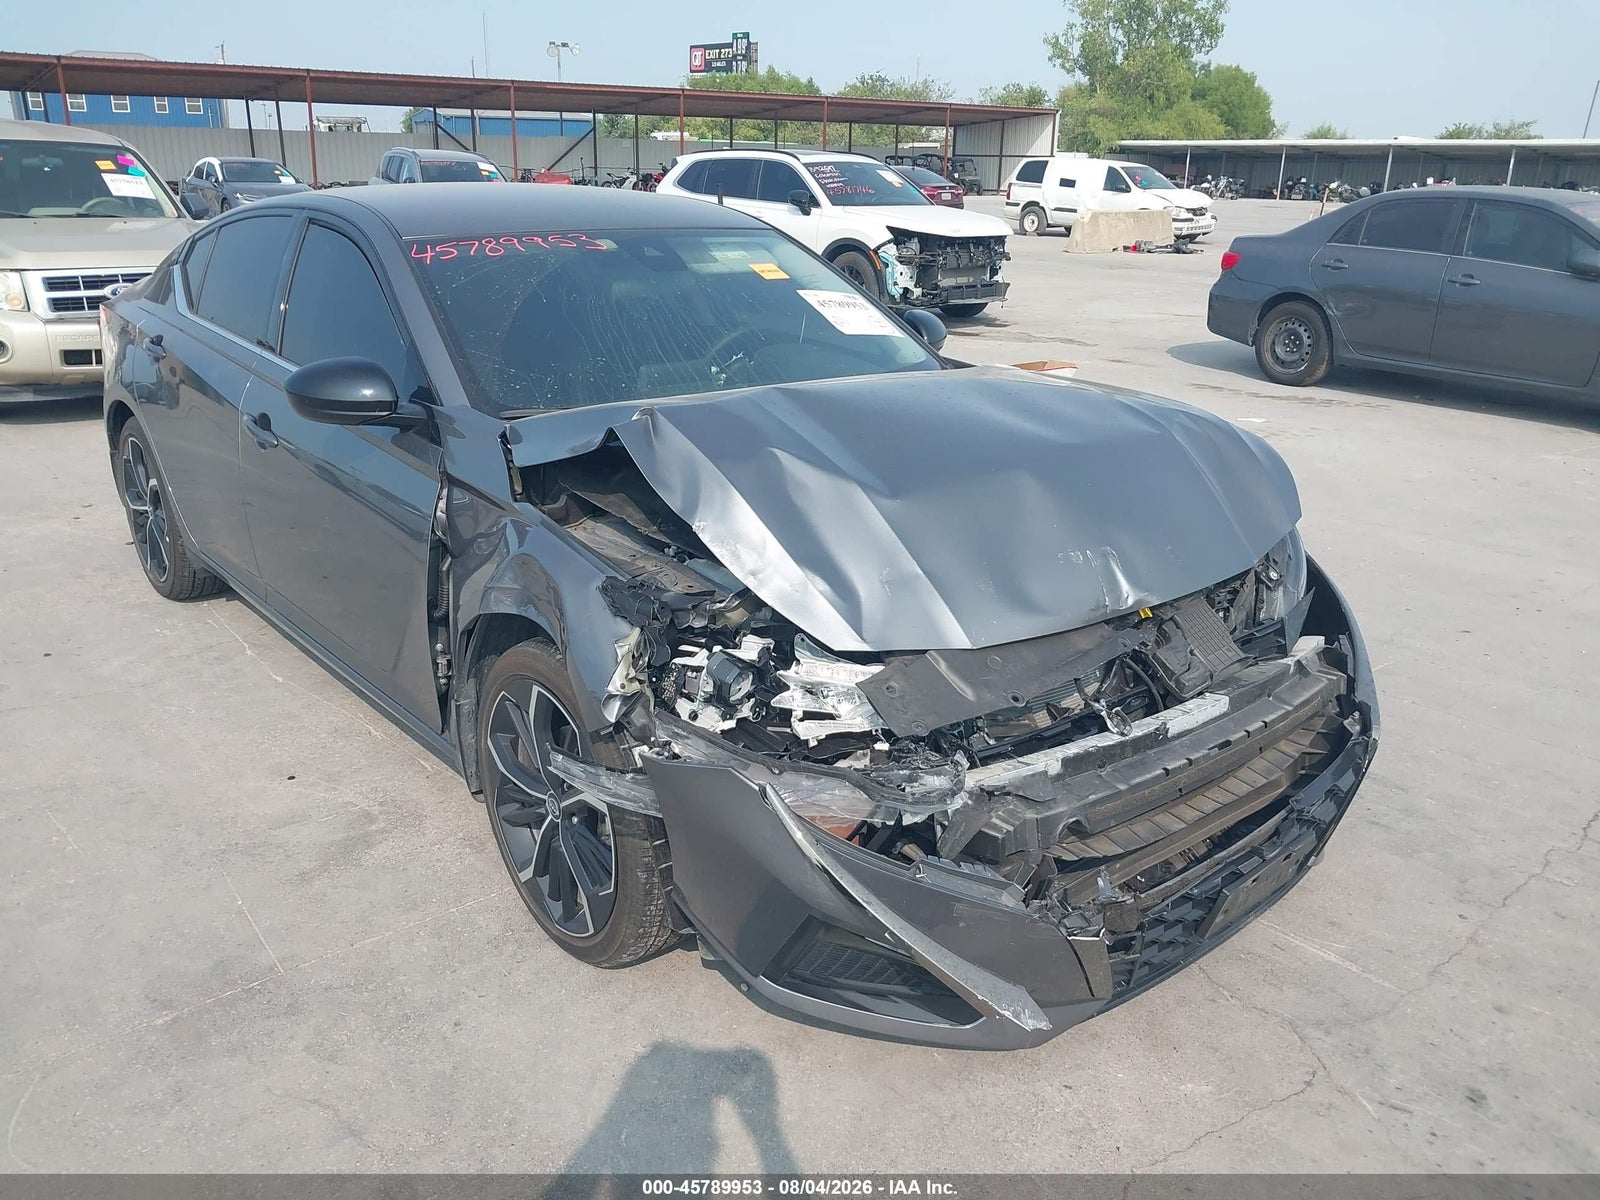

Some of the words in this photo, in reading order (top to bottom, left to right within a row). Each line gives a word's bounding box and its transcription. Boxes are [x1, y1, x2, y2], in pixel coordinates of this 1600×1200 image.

[692, 51, 703, 66] QT
[705, 50, 720, 59] EXIT
[720, 48, 733, 58] 273
[410, 233, 609, 265] 45789953
